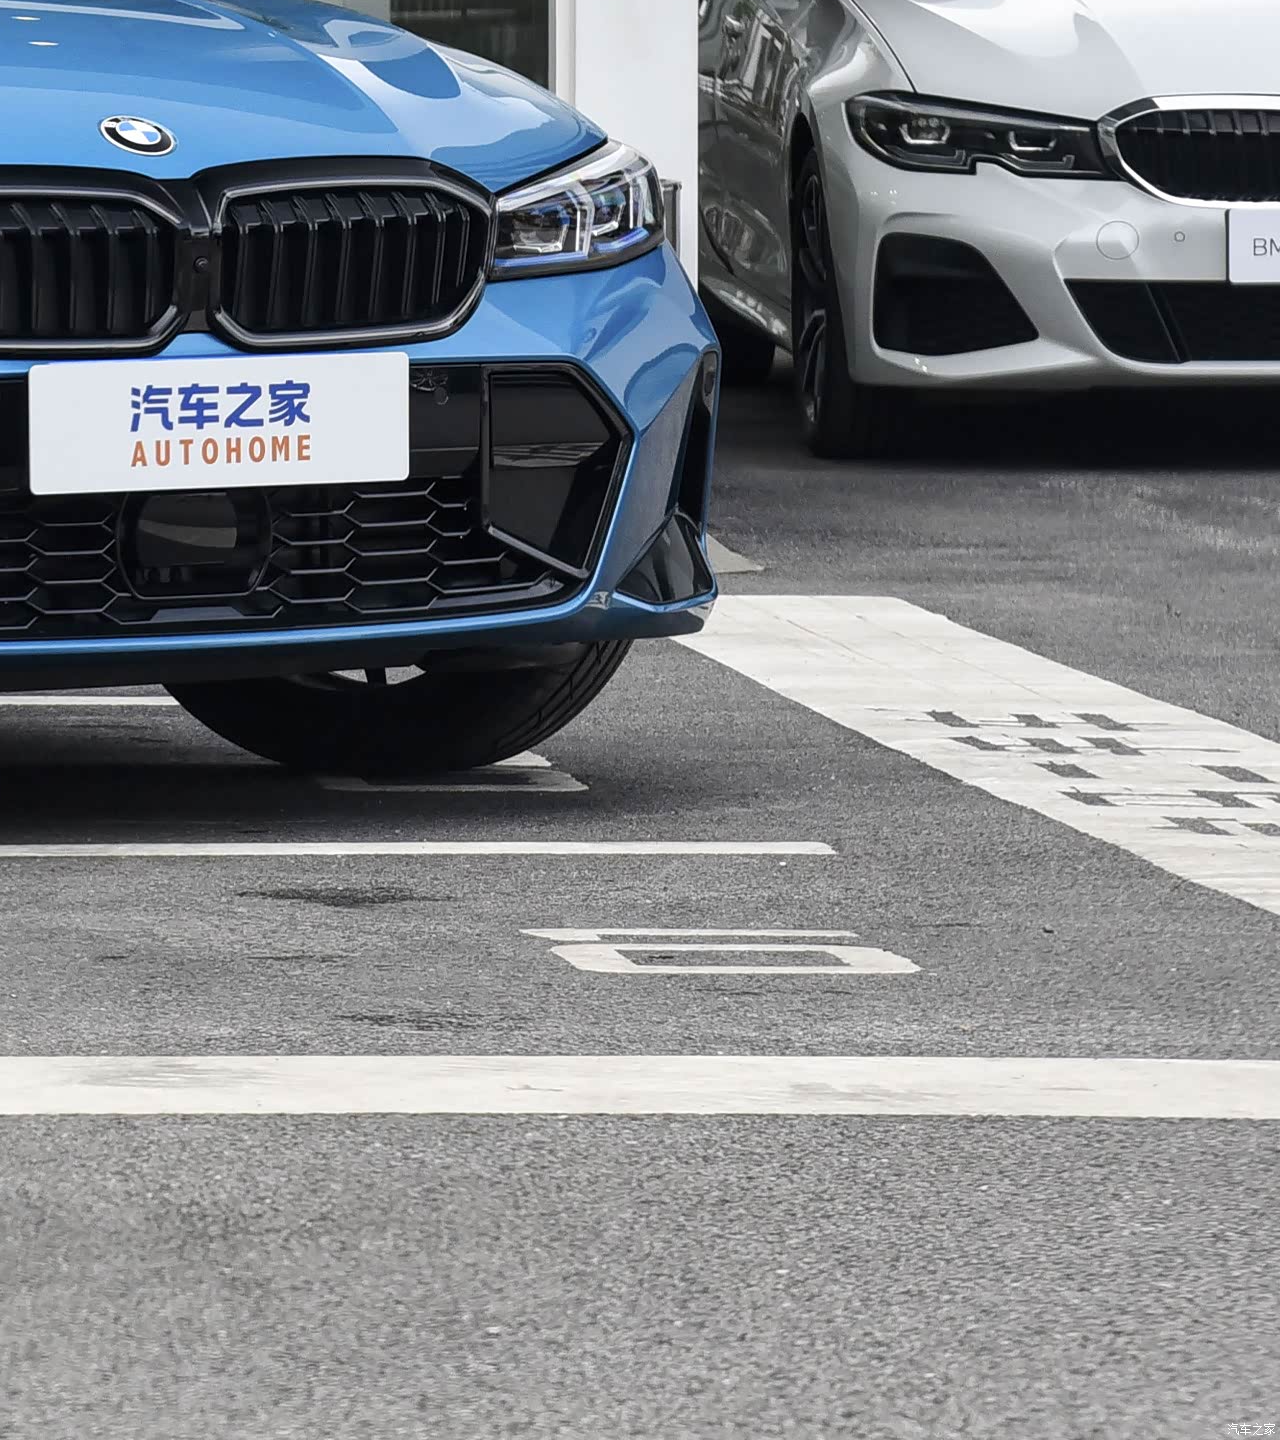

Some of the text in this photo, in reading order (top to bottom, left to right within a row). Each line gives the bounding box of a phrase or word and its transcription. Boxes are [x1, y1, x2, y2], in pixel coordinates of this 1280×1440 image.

[130, 380, 311, 433] 汽车之家
[130, 434, 311, 467] AUTOHOME
